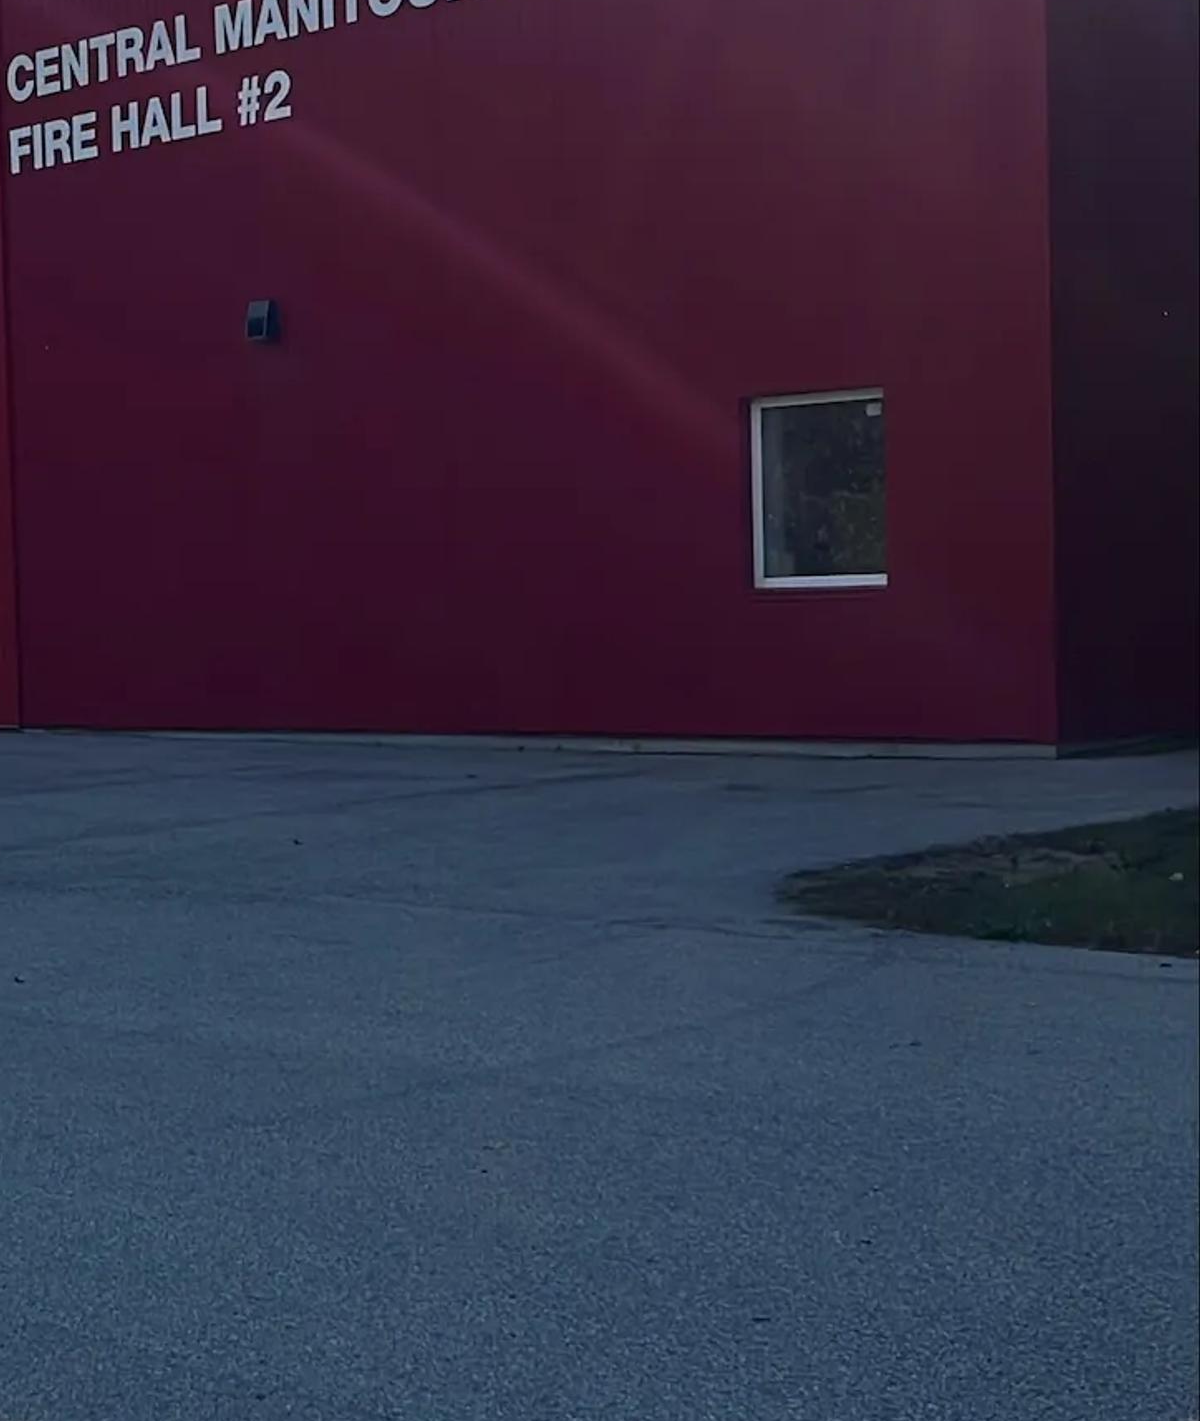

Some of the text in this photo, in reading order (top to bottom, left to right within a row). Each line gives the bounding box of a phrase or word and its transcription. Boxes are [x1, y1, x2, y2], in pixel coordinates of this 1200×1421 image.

[6, 14, 201, 102] CENTRAL
[8, 69, 292, 174] FIRE HALL #2
